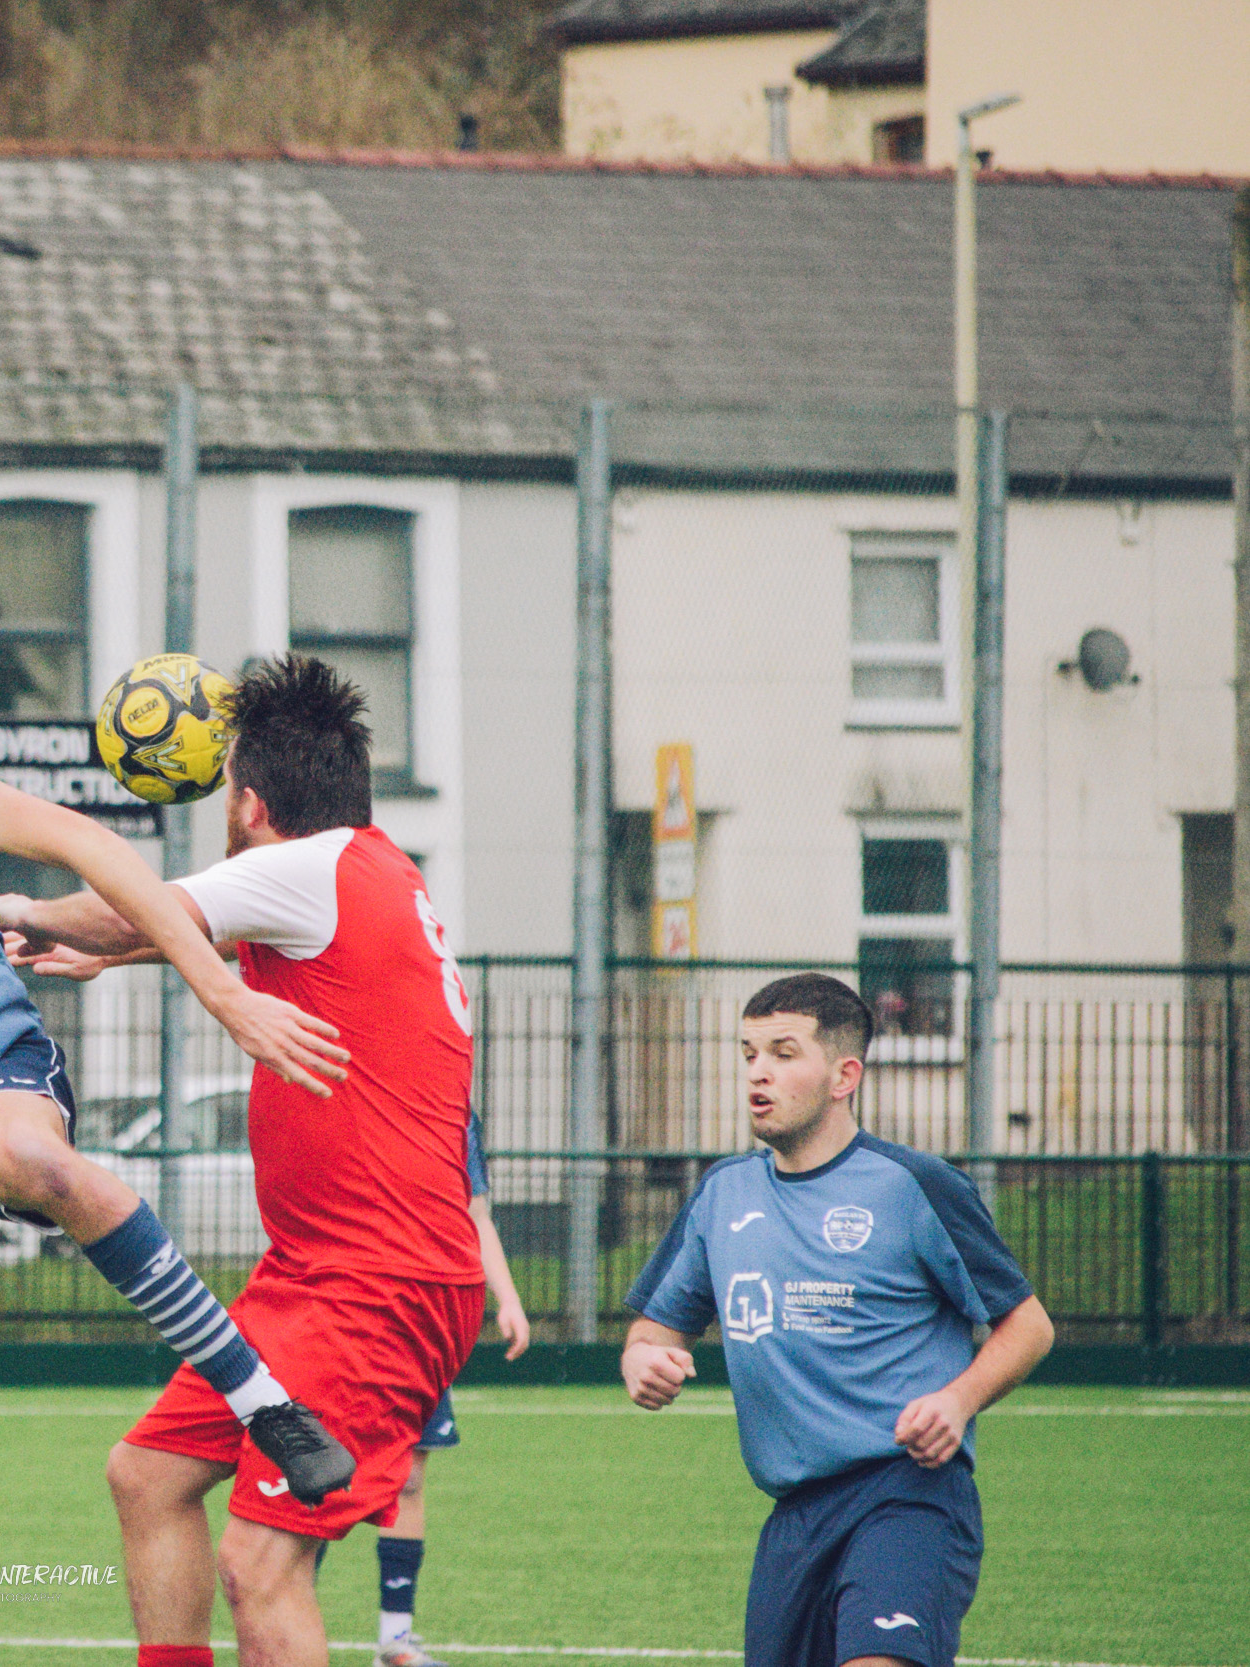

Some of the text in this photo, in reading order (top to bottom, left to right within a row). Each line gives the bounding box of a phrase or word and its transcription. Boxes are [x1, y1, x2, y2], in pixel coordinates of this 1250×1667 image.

[785, 1281, 855, 1295] GJ PROPERTY
[785, 1294, 854, 1308] MAINTENANCE
